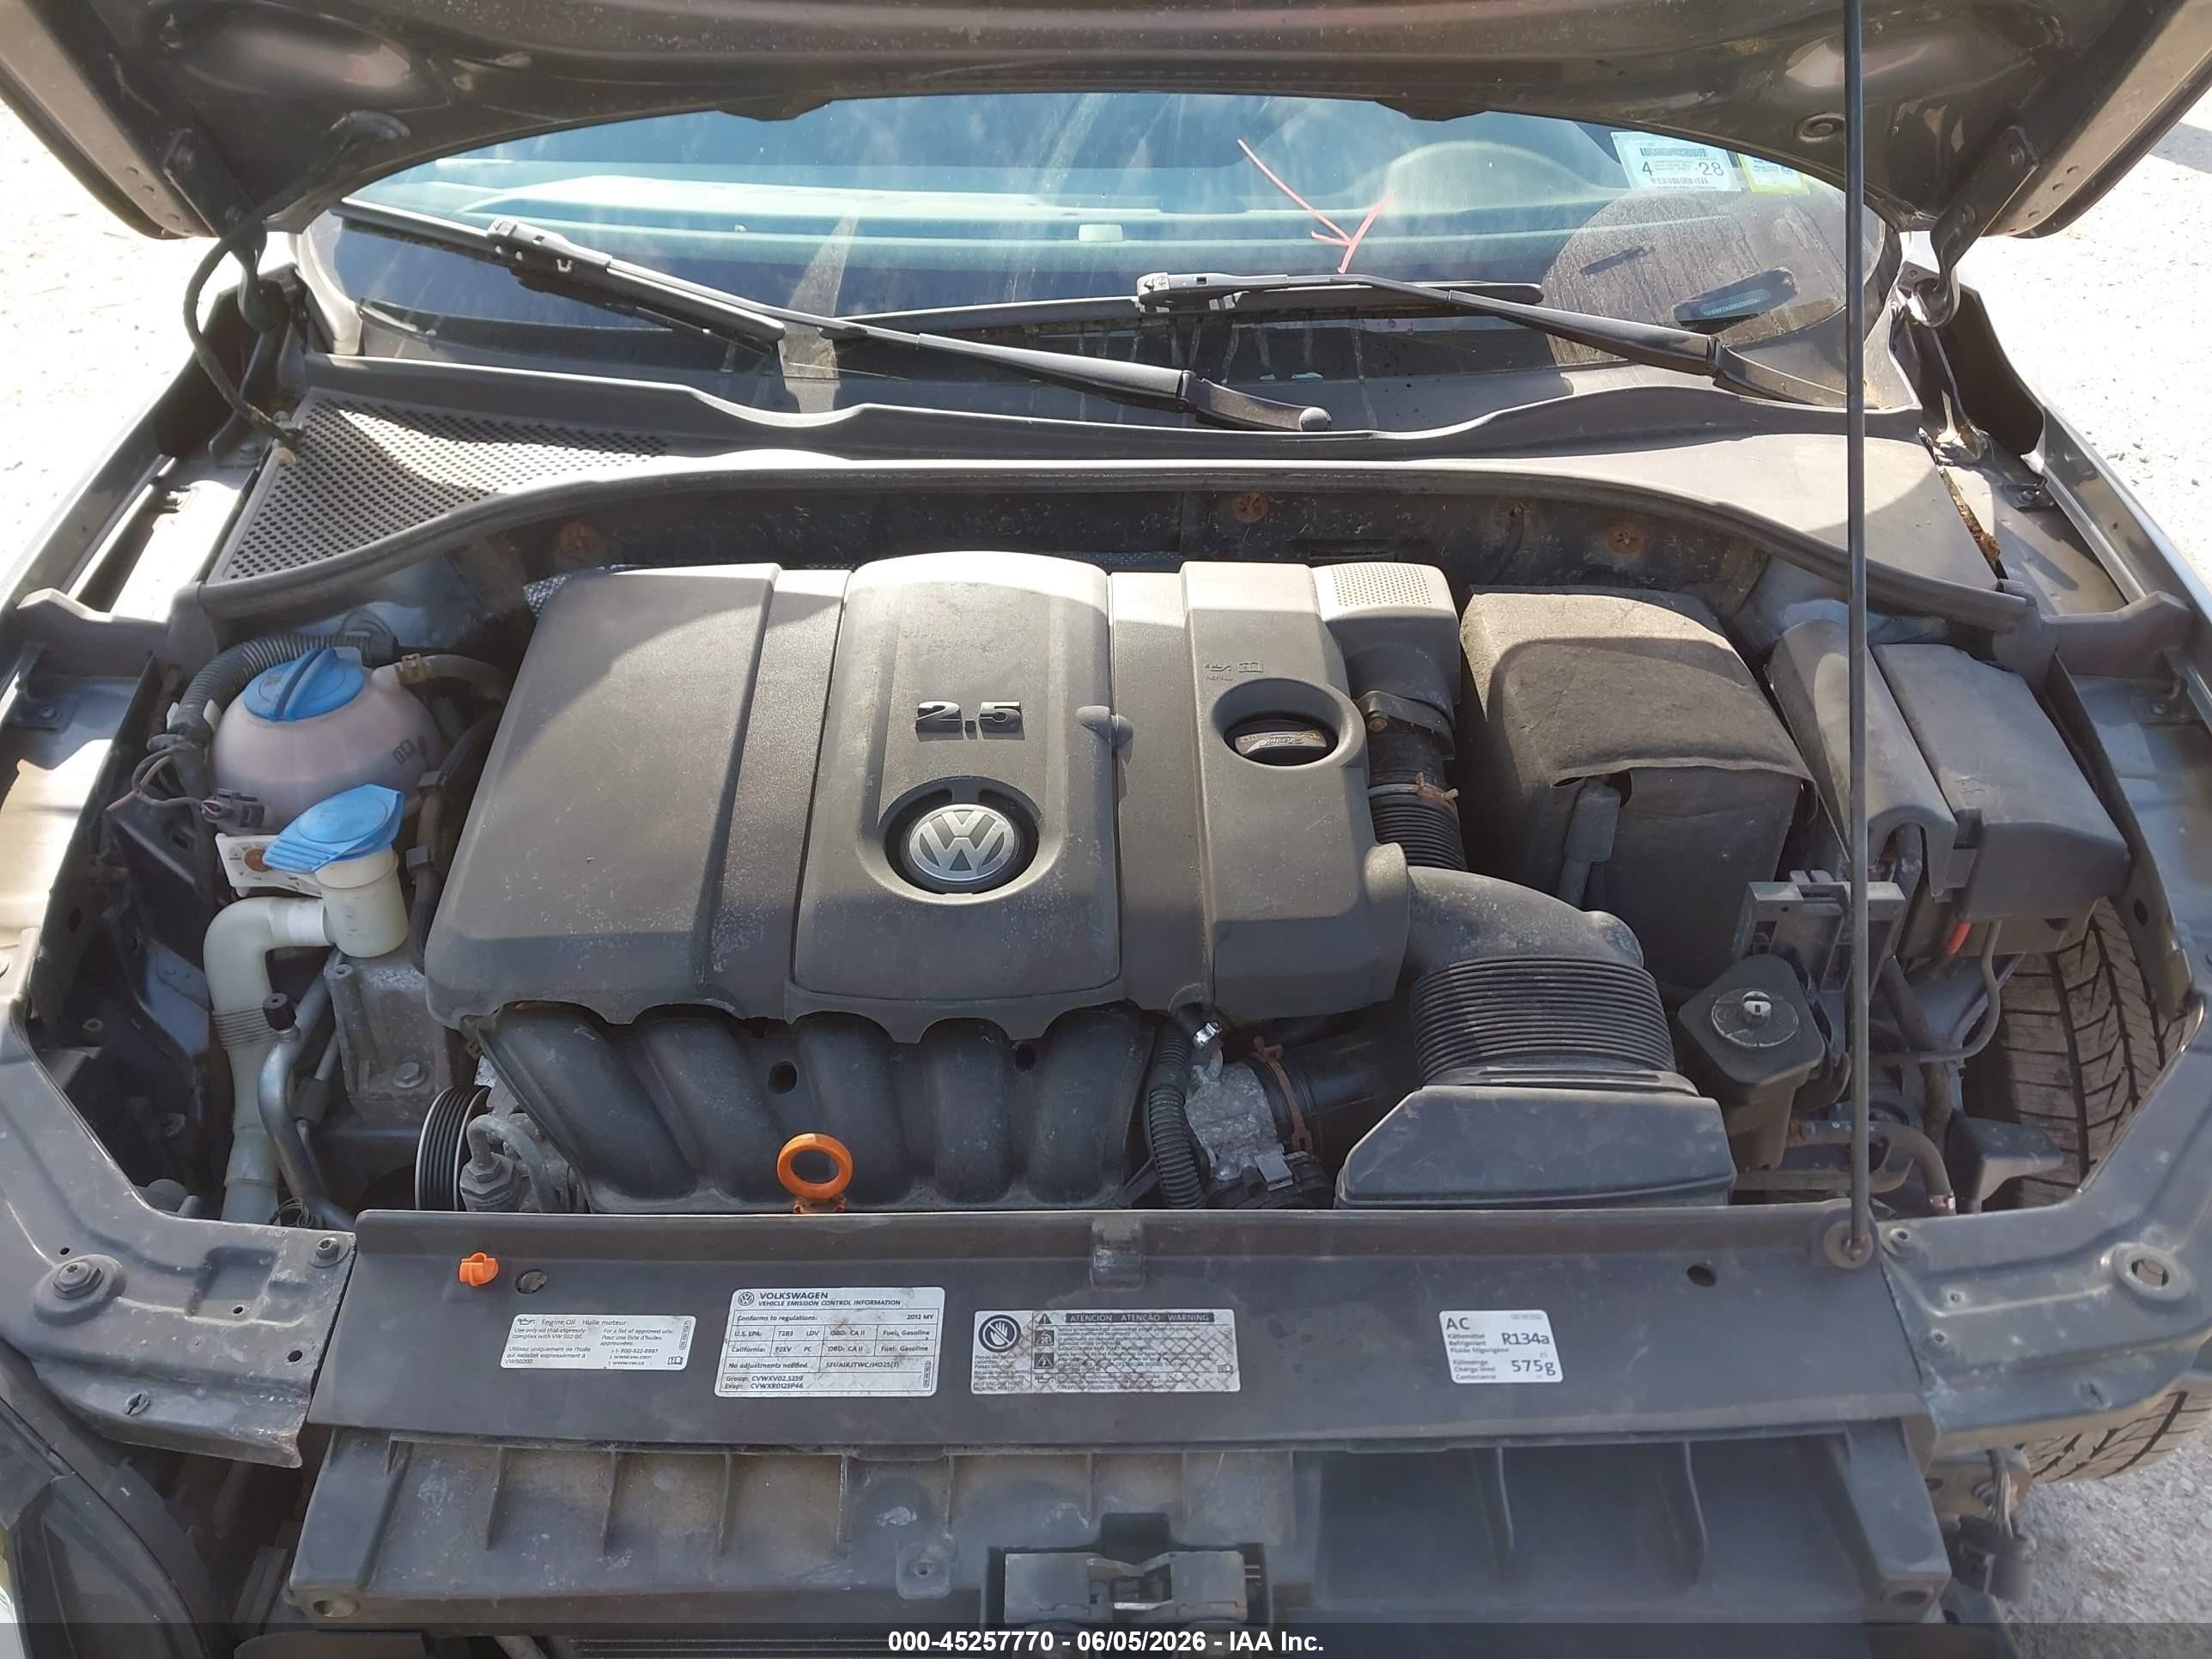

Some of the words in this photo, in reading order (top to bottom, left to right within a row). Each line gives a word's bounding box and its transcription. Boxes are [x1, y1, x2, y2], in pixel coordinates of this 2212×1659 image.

[1642, 161, 1653, 176] 4
[1698, 161, 1724, 177] 28
[915, 701, 1023, 737] 2.5
[1446, 1317, 1470, 1329] AC
[1501, 1332, 1550, 1345] R134a
